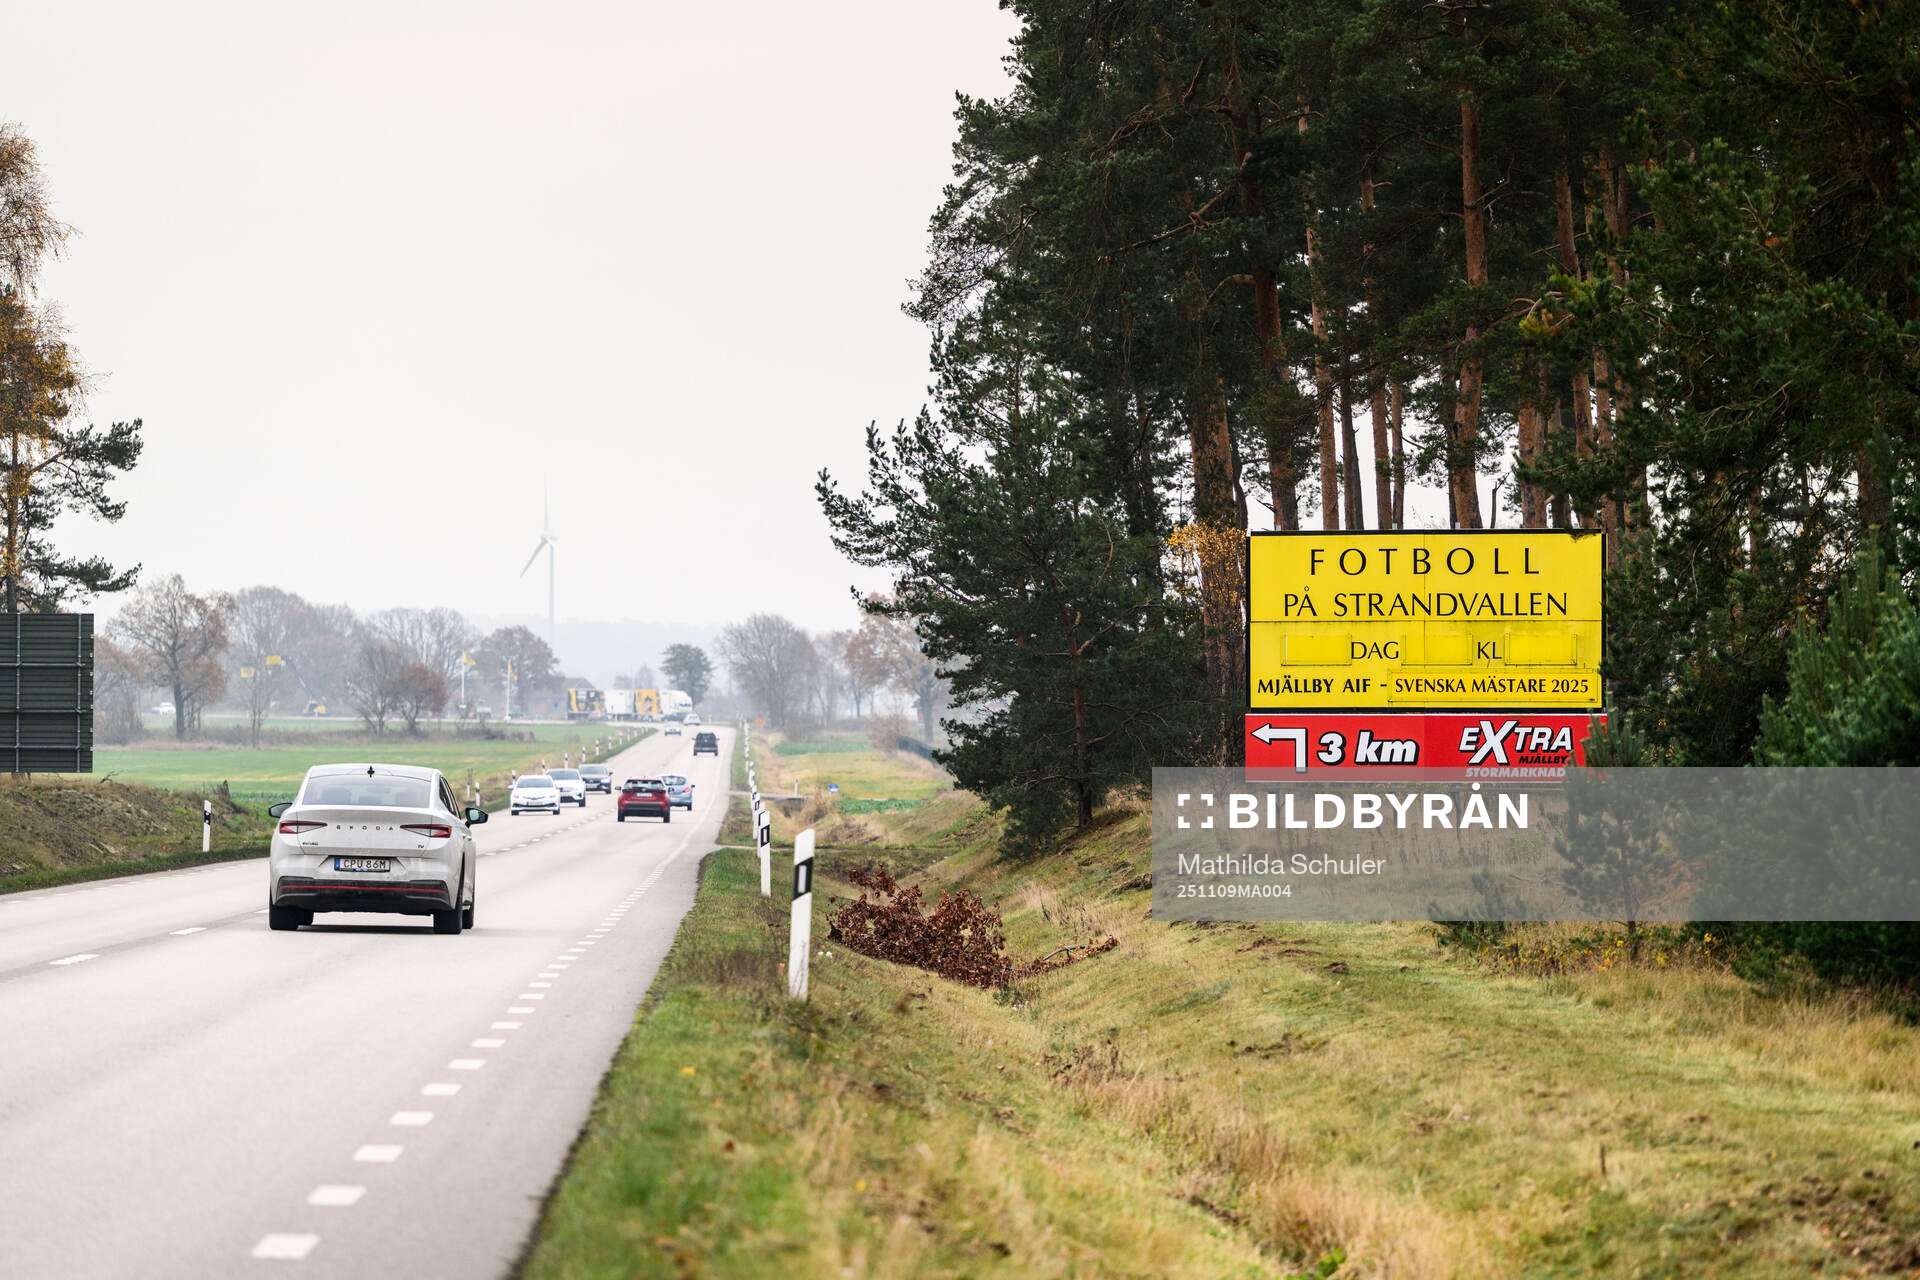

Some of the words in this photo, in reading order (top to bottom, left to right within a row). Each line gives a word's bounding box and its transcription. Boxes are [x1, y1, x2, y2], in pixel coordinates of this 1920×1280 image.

[1310, 547, 1540, 576] FOTBOLL
[1284, 586, 1317, 616] PÅ
[1334, 592, 1568, 617] STRANDVALLEN
[1351, 641, 1399, 660] DAG
[1477, 641, 1503, 660] KL
[1257, 674, 1334, 696] MJÄLLBY
[1342, 678, 1371, 693] AIF
[1395, 678, 1466, 693] SVENSKA
[1471, 675, 1547, 693] MÄSTARE
[1551, 679, 1589, 693] 2025
[1317, 731, 1348, 765] 3
[1355, 730, 1420, 766] km
[1459, 720, 1575, 766] EXTRA
[1518, 752, 1568, 765] MJÄLLBY
[1465, 767, 1566, 778] STORMARKNAD
